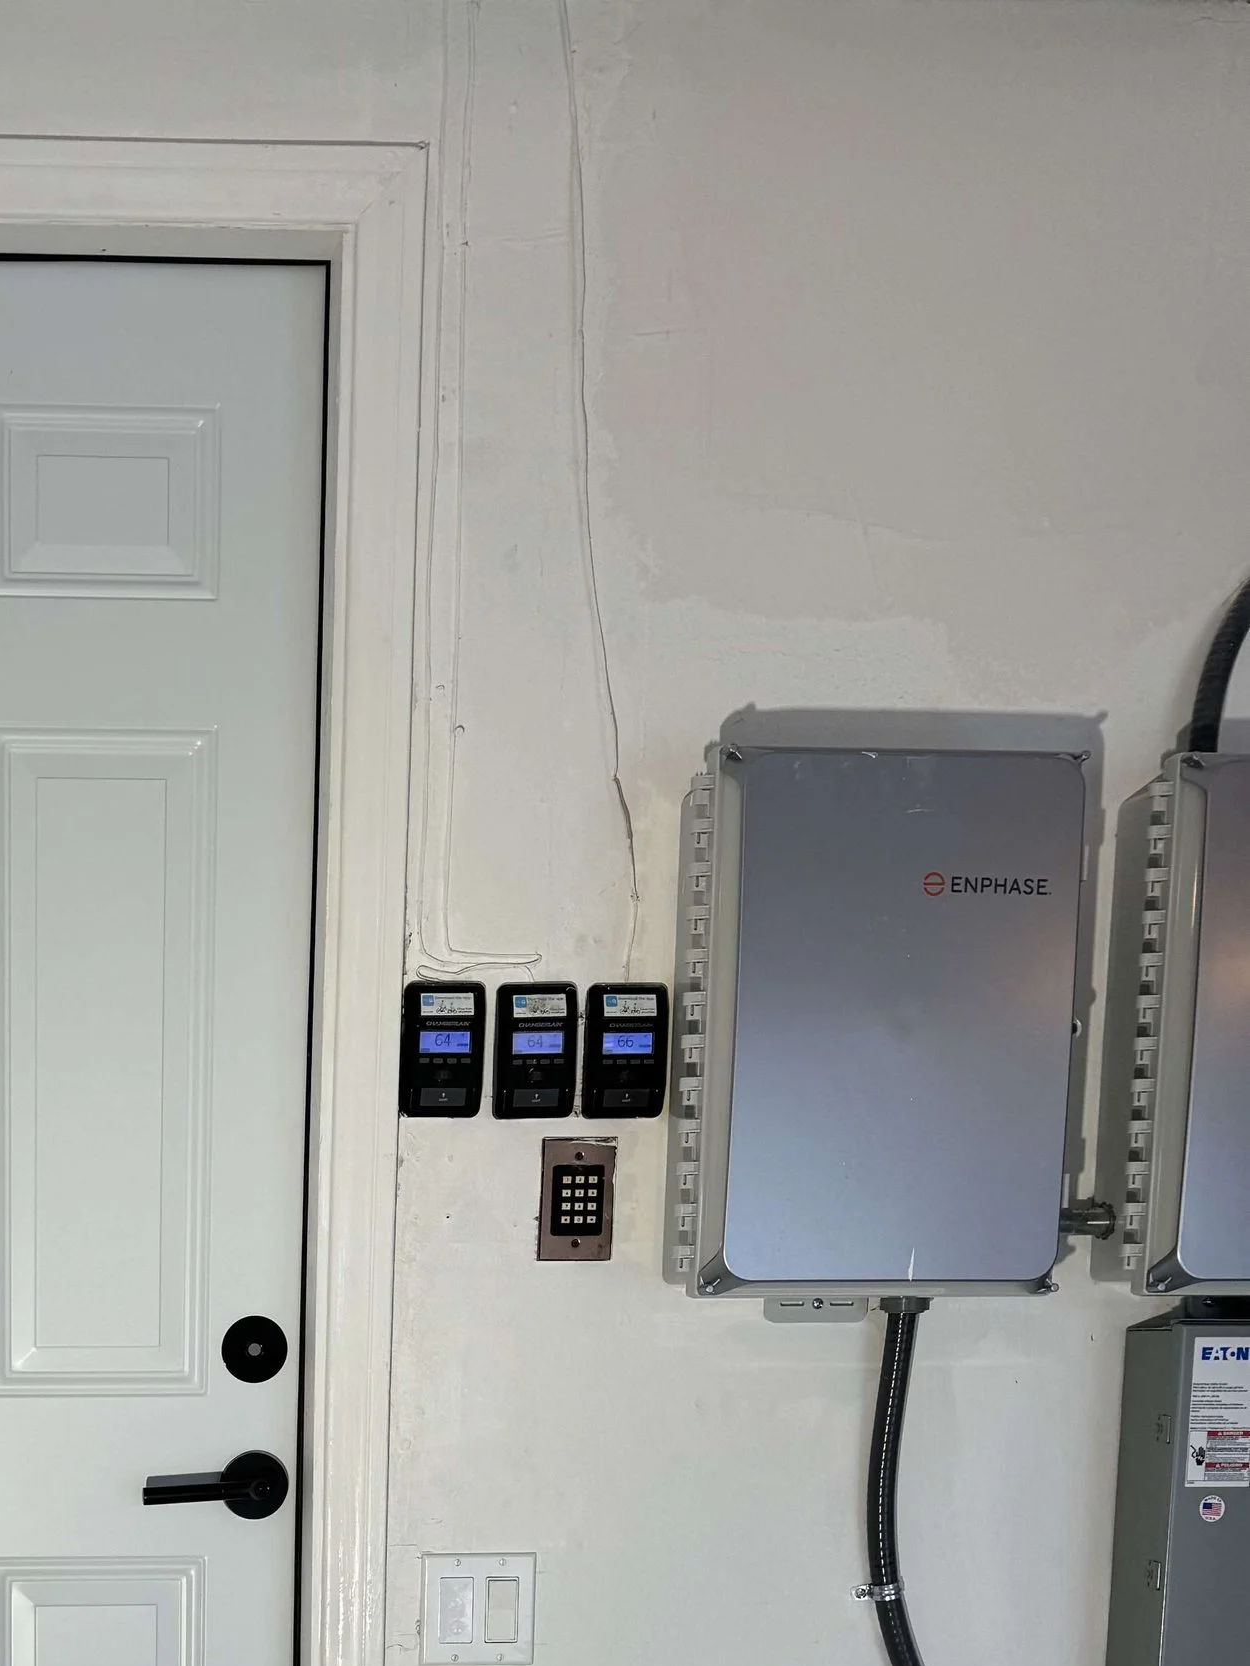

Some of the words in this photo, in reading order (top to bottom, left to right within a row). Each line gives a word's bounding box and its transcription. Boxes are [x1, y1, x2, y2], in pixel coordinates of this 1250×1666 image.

[434, 1033, 451, 1047] 64
[617, 1035, 634, 1048] 66
[1201, 1346, 1249, 1361] EATON
